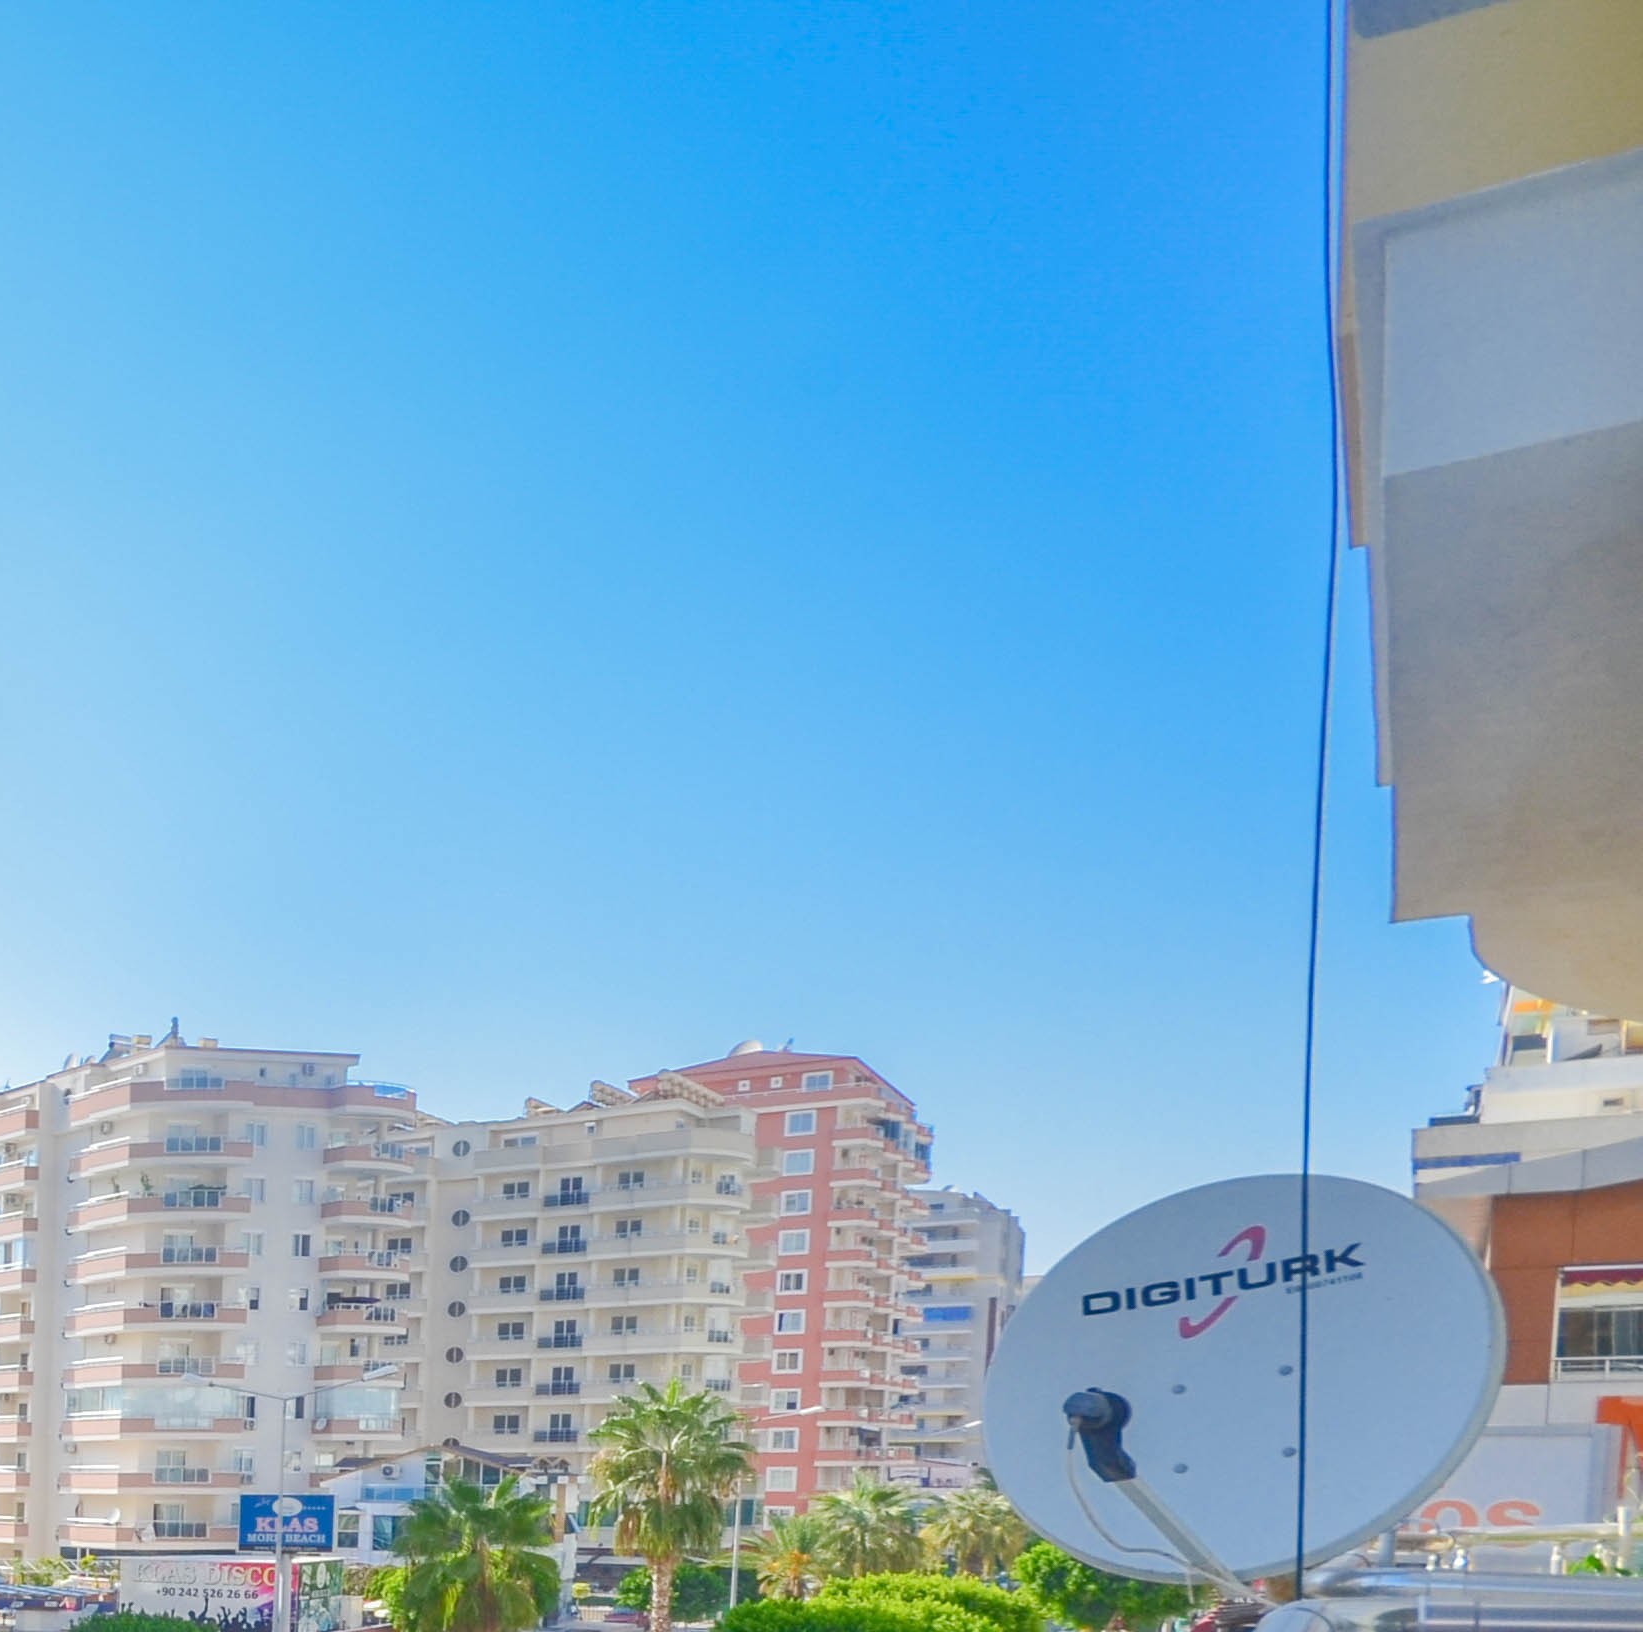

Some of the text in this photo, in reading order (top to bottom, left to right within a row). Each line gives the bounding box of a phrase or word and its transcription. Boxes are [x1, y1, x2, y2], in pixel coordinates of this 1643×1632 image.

[1082, 1241, 1365, 1316] DIGITURK
[284, 1534, 326, 1544] BEACH
[132, 1563, 197, 1584] KLAS
[156, 1587, 259, 1600] +90 242 526 26 66
